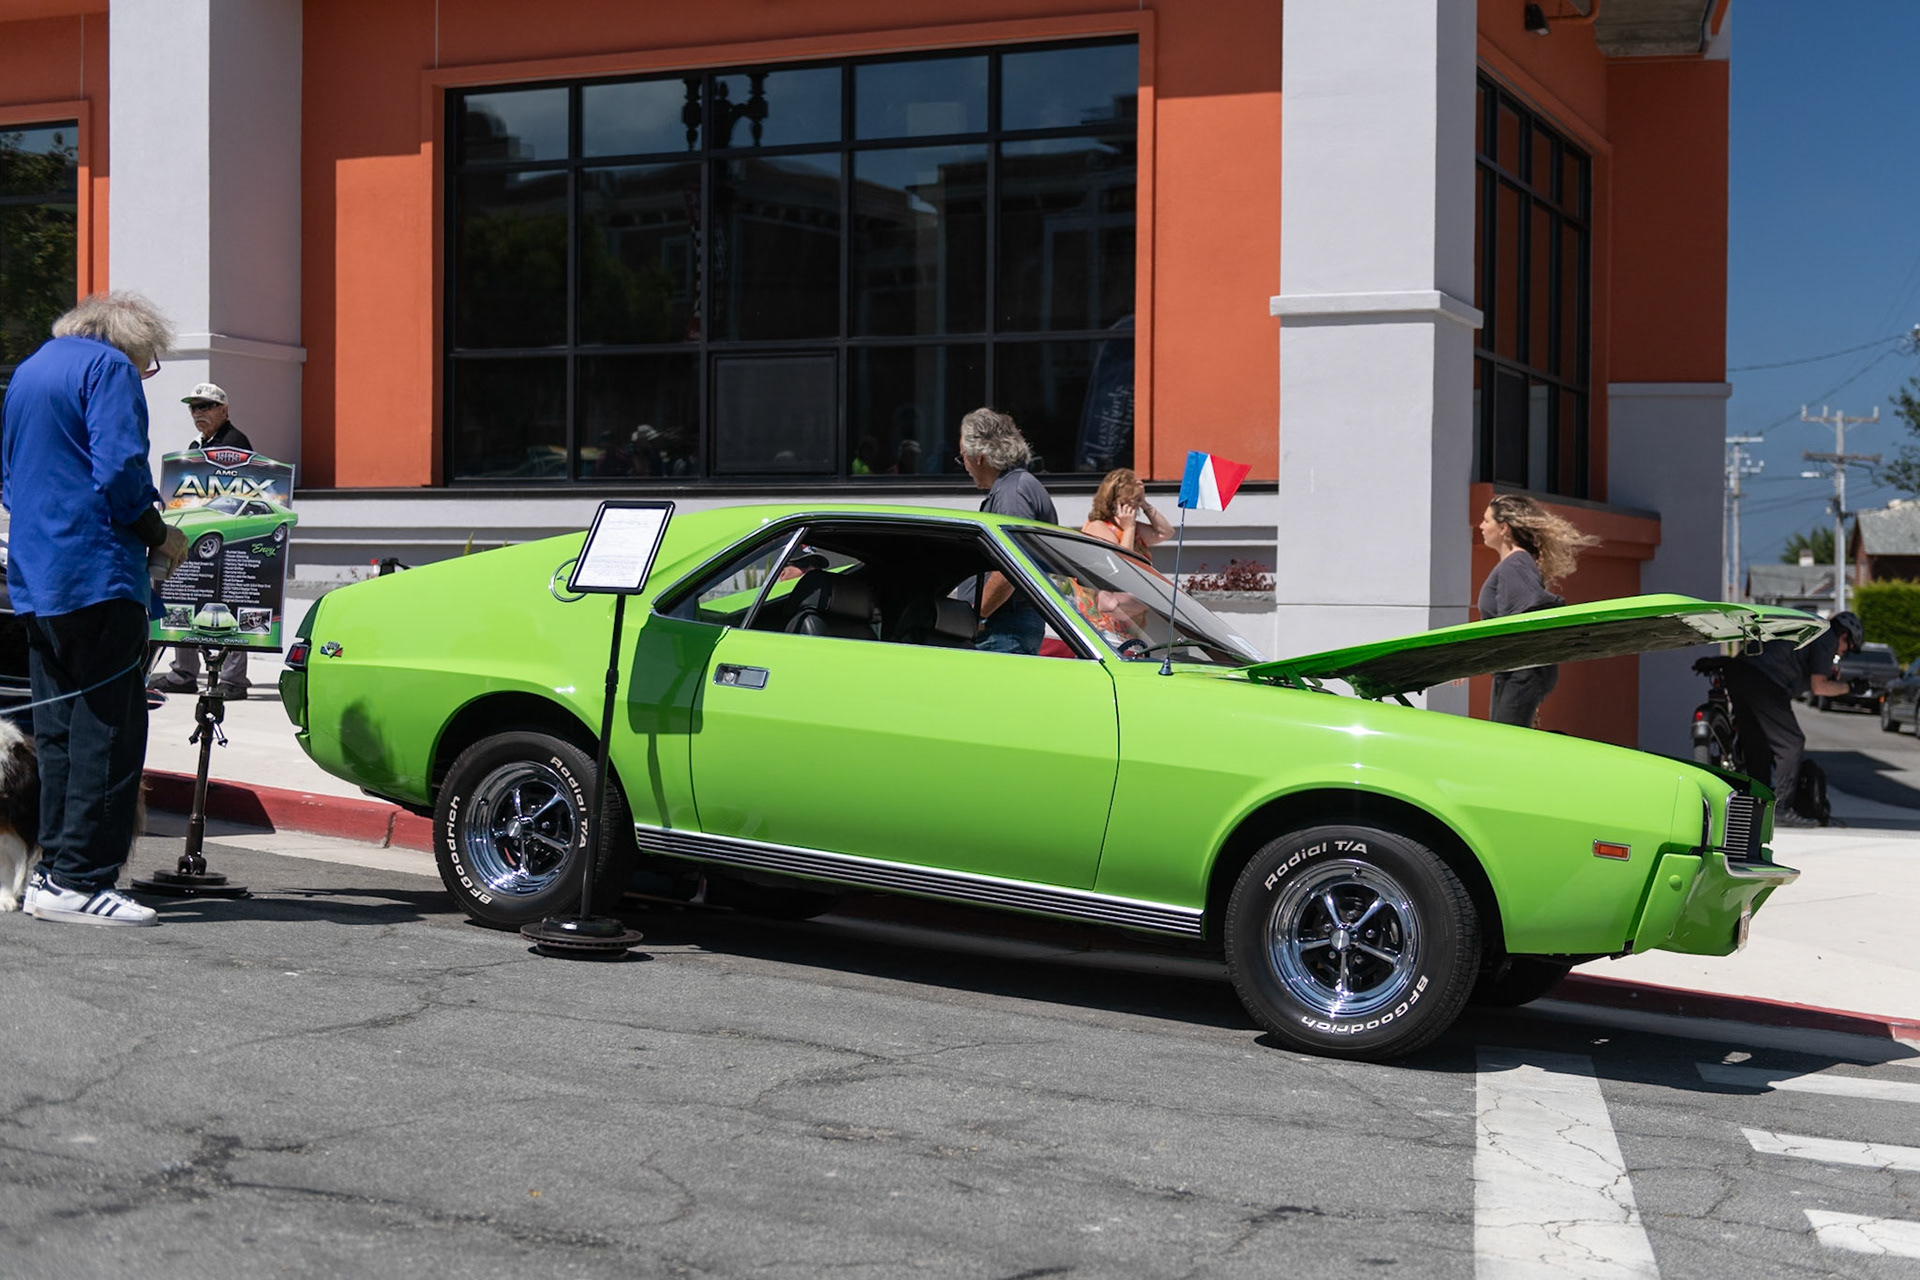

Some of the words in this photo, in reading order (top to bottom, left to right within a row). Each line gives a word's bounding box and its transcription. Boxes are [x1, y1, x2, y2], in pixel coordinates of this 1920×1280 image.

[173, 475, 276, 498] AMX
[549, 755, 587, 812] Radial
[578, 817, 589, 848] T/A
[446, 795, 493, 905] BFGoodrich
[1263, 842, 1328, 891] Radial
[1333, 840, 1368, 854] T/A
[1300, 973, 1430, 1035] BFGoodrich
